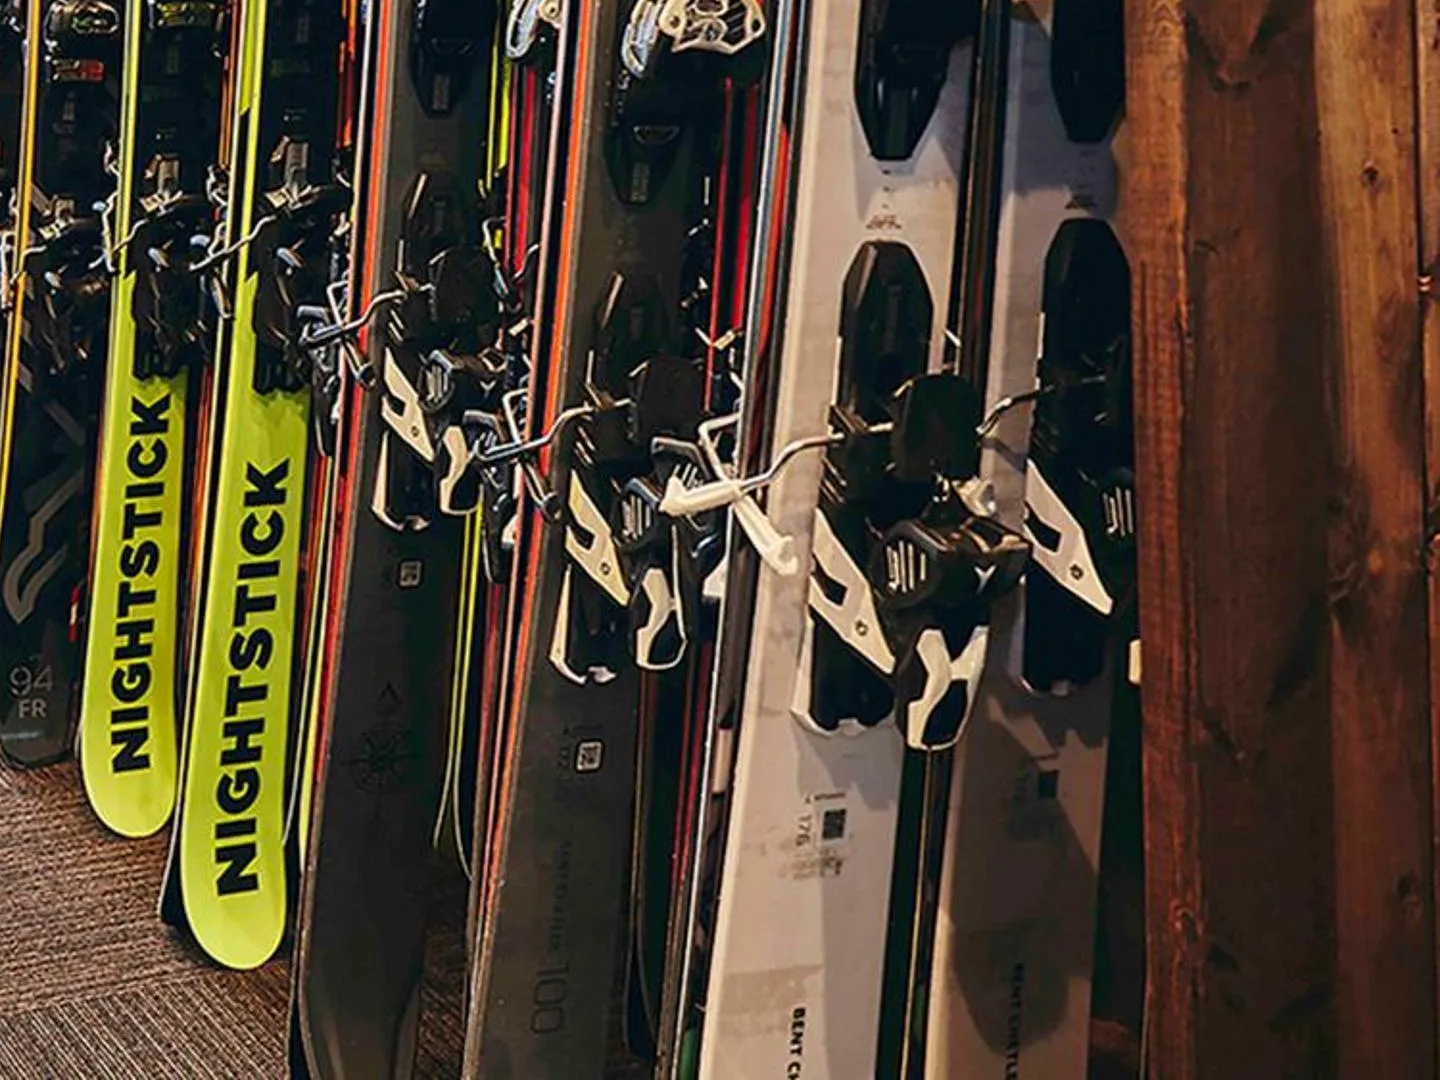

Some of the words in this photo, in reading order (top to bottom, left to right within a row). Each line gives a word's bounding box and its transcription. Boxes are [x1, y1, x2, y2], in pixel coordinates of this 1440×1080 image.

[111, 394, 172, 774] NIGHTSTICK
[10, 665, 53, 697] 94
[215, 457, 292, 896] NIGHTSTICK
[18, 699, 47, 719] FR
[789, 1006, 807, 1056] BENT
